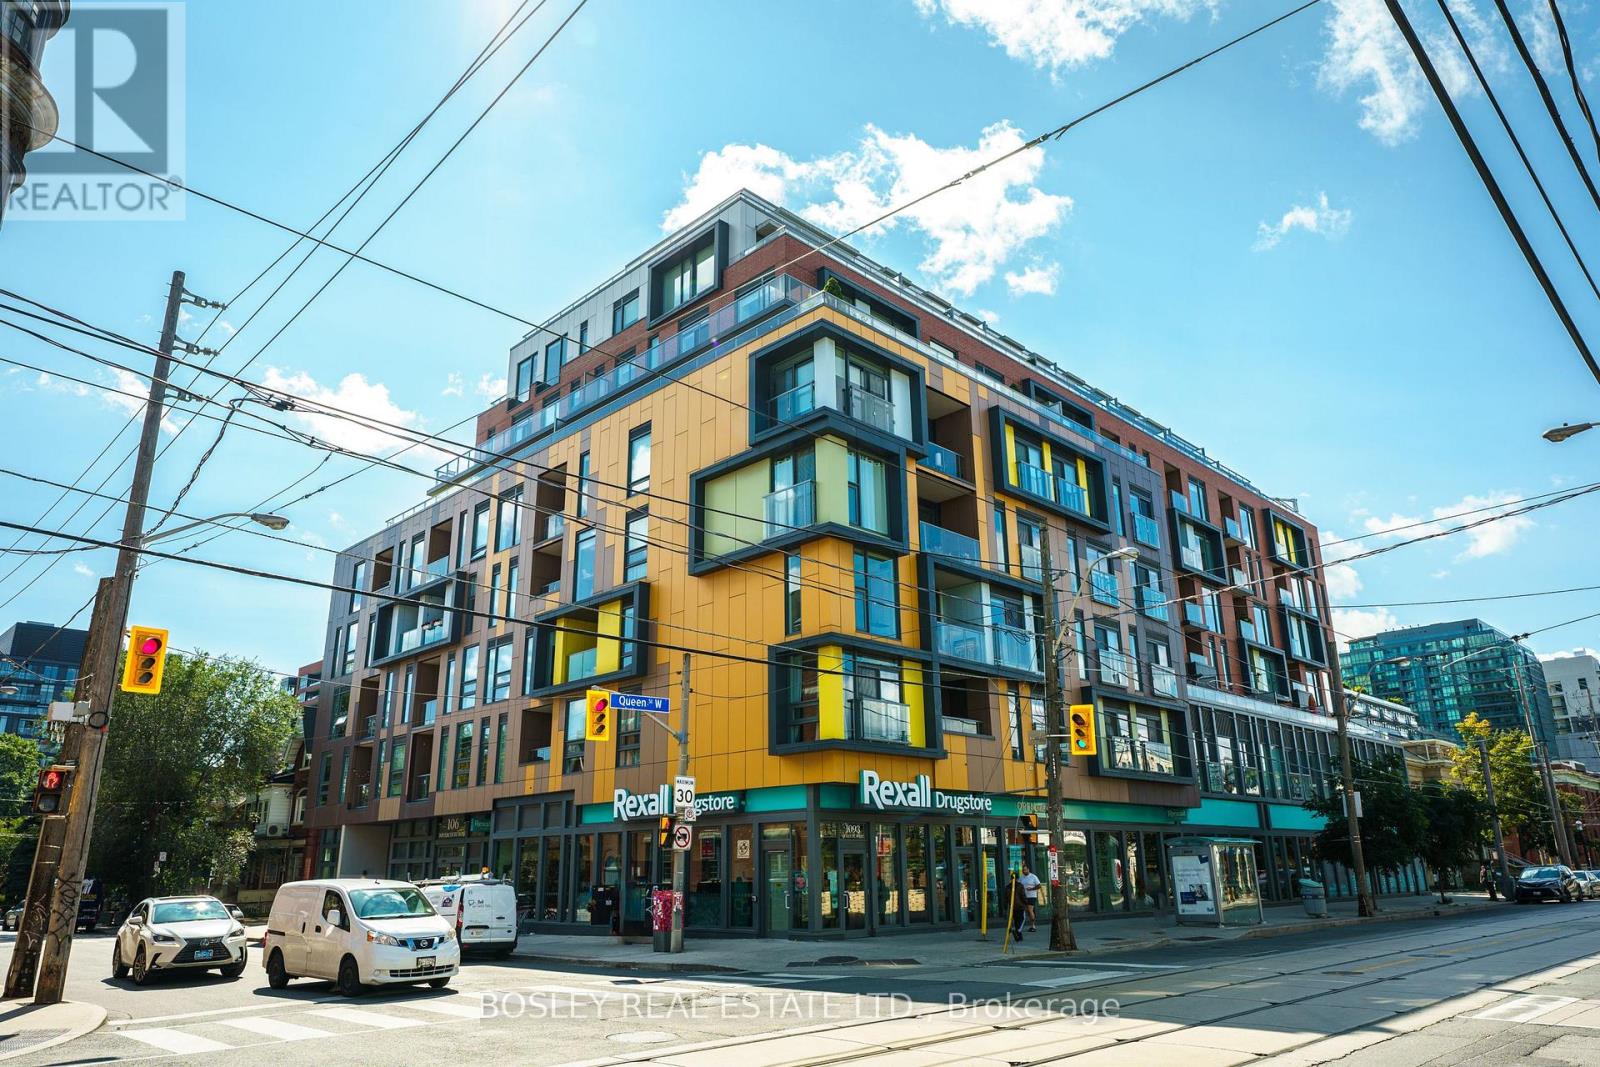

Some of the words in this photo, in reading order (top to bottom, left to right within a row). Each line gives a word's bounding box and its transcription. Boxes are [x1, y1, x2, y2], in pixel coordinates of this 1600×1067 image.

[618, 695, 647, 707] Queen
[654, 699, 663, 709] W
[613, 783, 670, 821] Rexall
[674, 794, 735, 816] gstore
[676, 789, 693, 803] 30
[861, 769, 932, 810] Rexall
[935, 791, 992, 814] Drugstore
